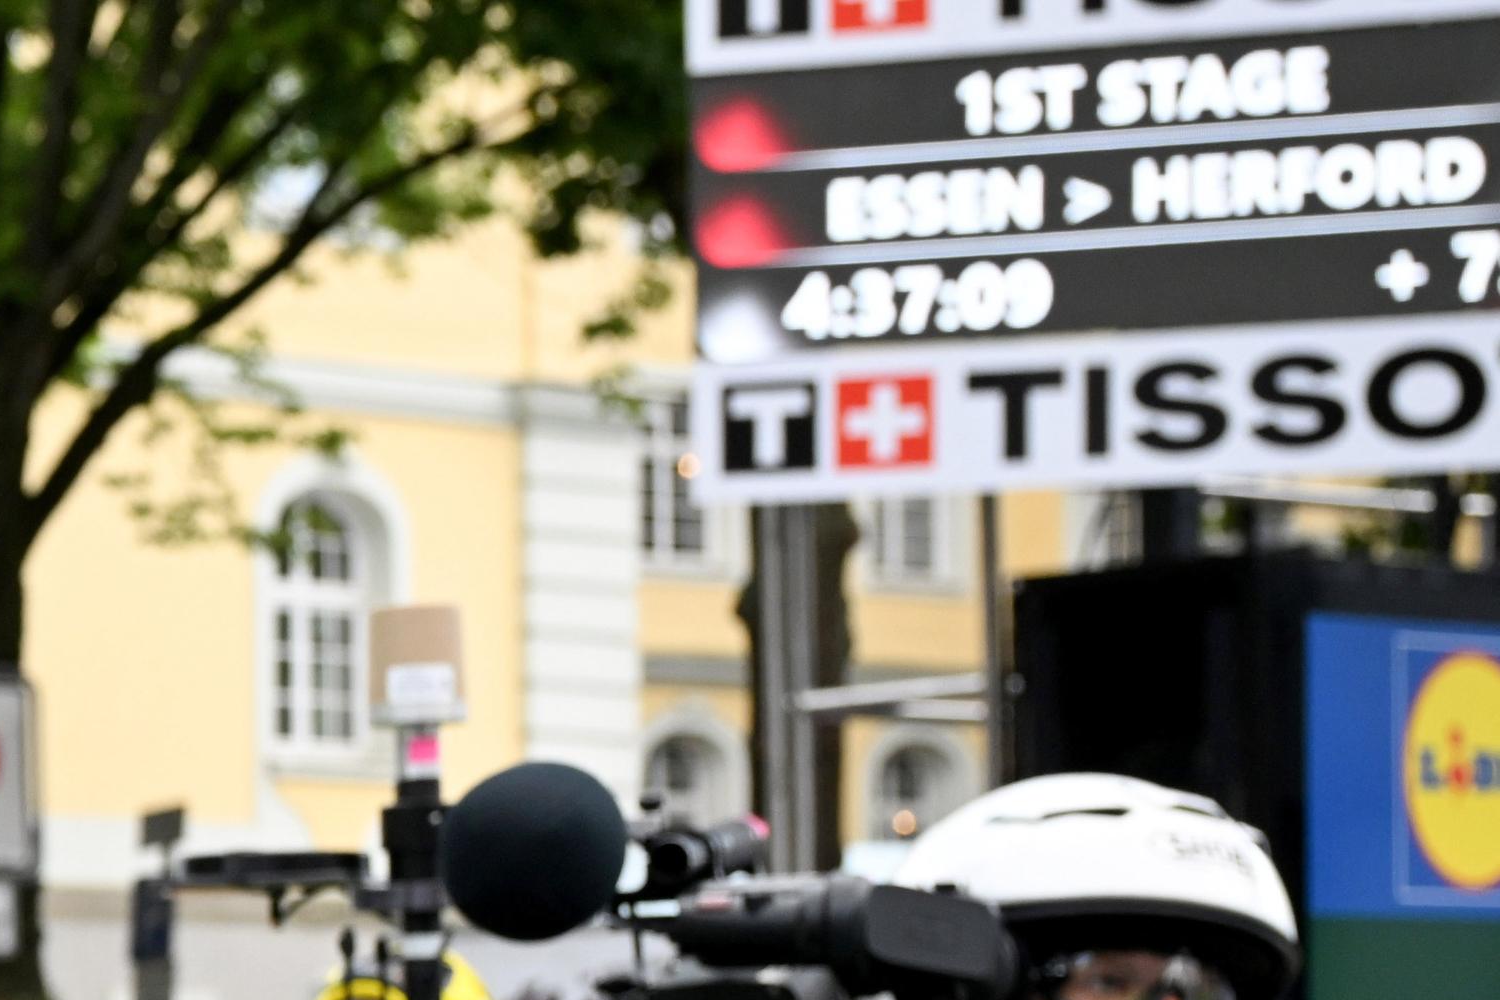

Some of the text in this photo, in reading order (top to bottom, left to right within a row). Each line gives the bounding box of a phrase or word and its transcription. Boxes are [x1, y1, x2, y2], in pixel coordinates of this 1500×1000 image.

[955, 45, 1332, 136] 1ST STAGE
[825, 165, 1044, 243] ESSEN
[1131, 136, 1487, 224] HERFORD
[781, 259, 1055, 340] 4:37:09
[1449, 228, 1500, 304] 7
[967, 346, 1500, 462] TISSO
